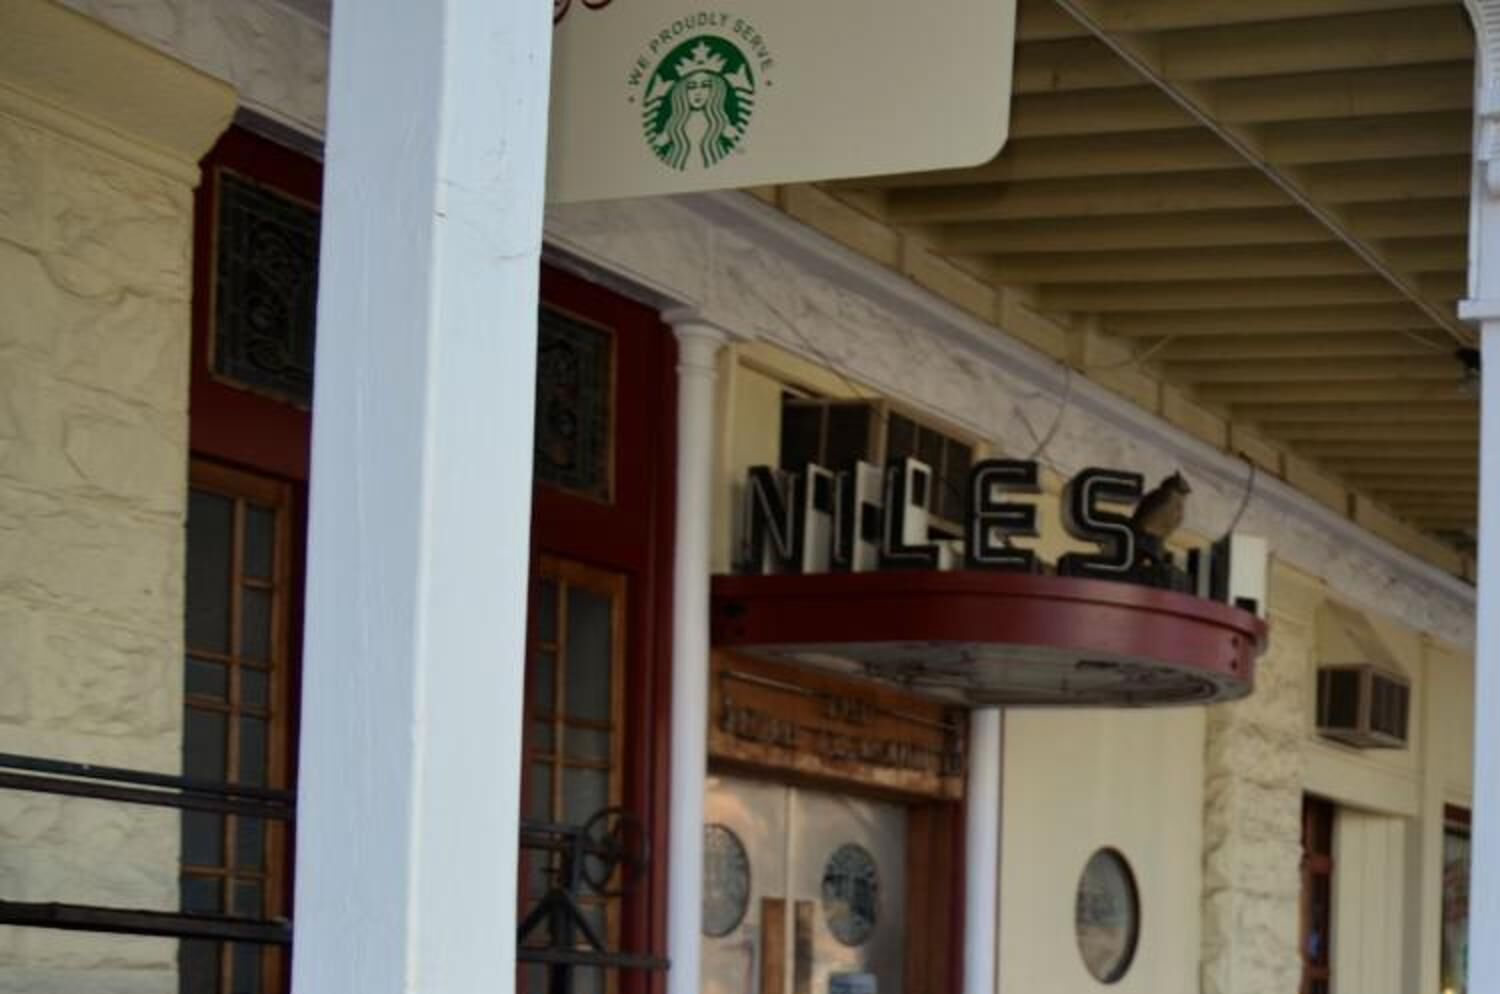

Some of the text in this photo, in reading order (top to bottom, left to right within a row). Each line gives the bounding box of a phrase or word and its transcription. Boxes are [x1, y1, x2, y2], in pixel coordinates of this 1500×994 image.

[628, 54, 648, 86] WE
[649, 11, 729, 52] PROUDLY
[734, 18, 774, 72] SERVE
[742, 457, 1146, 577] NILES
